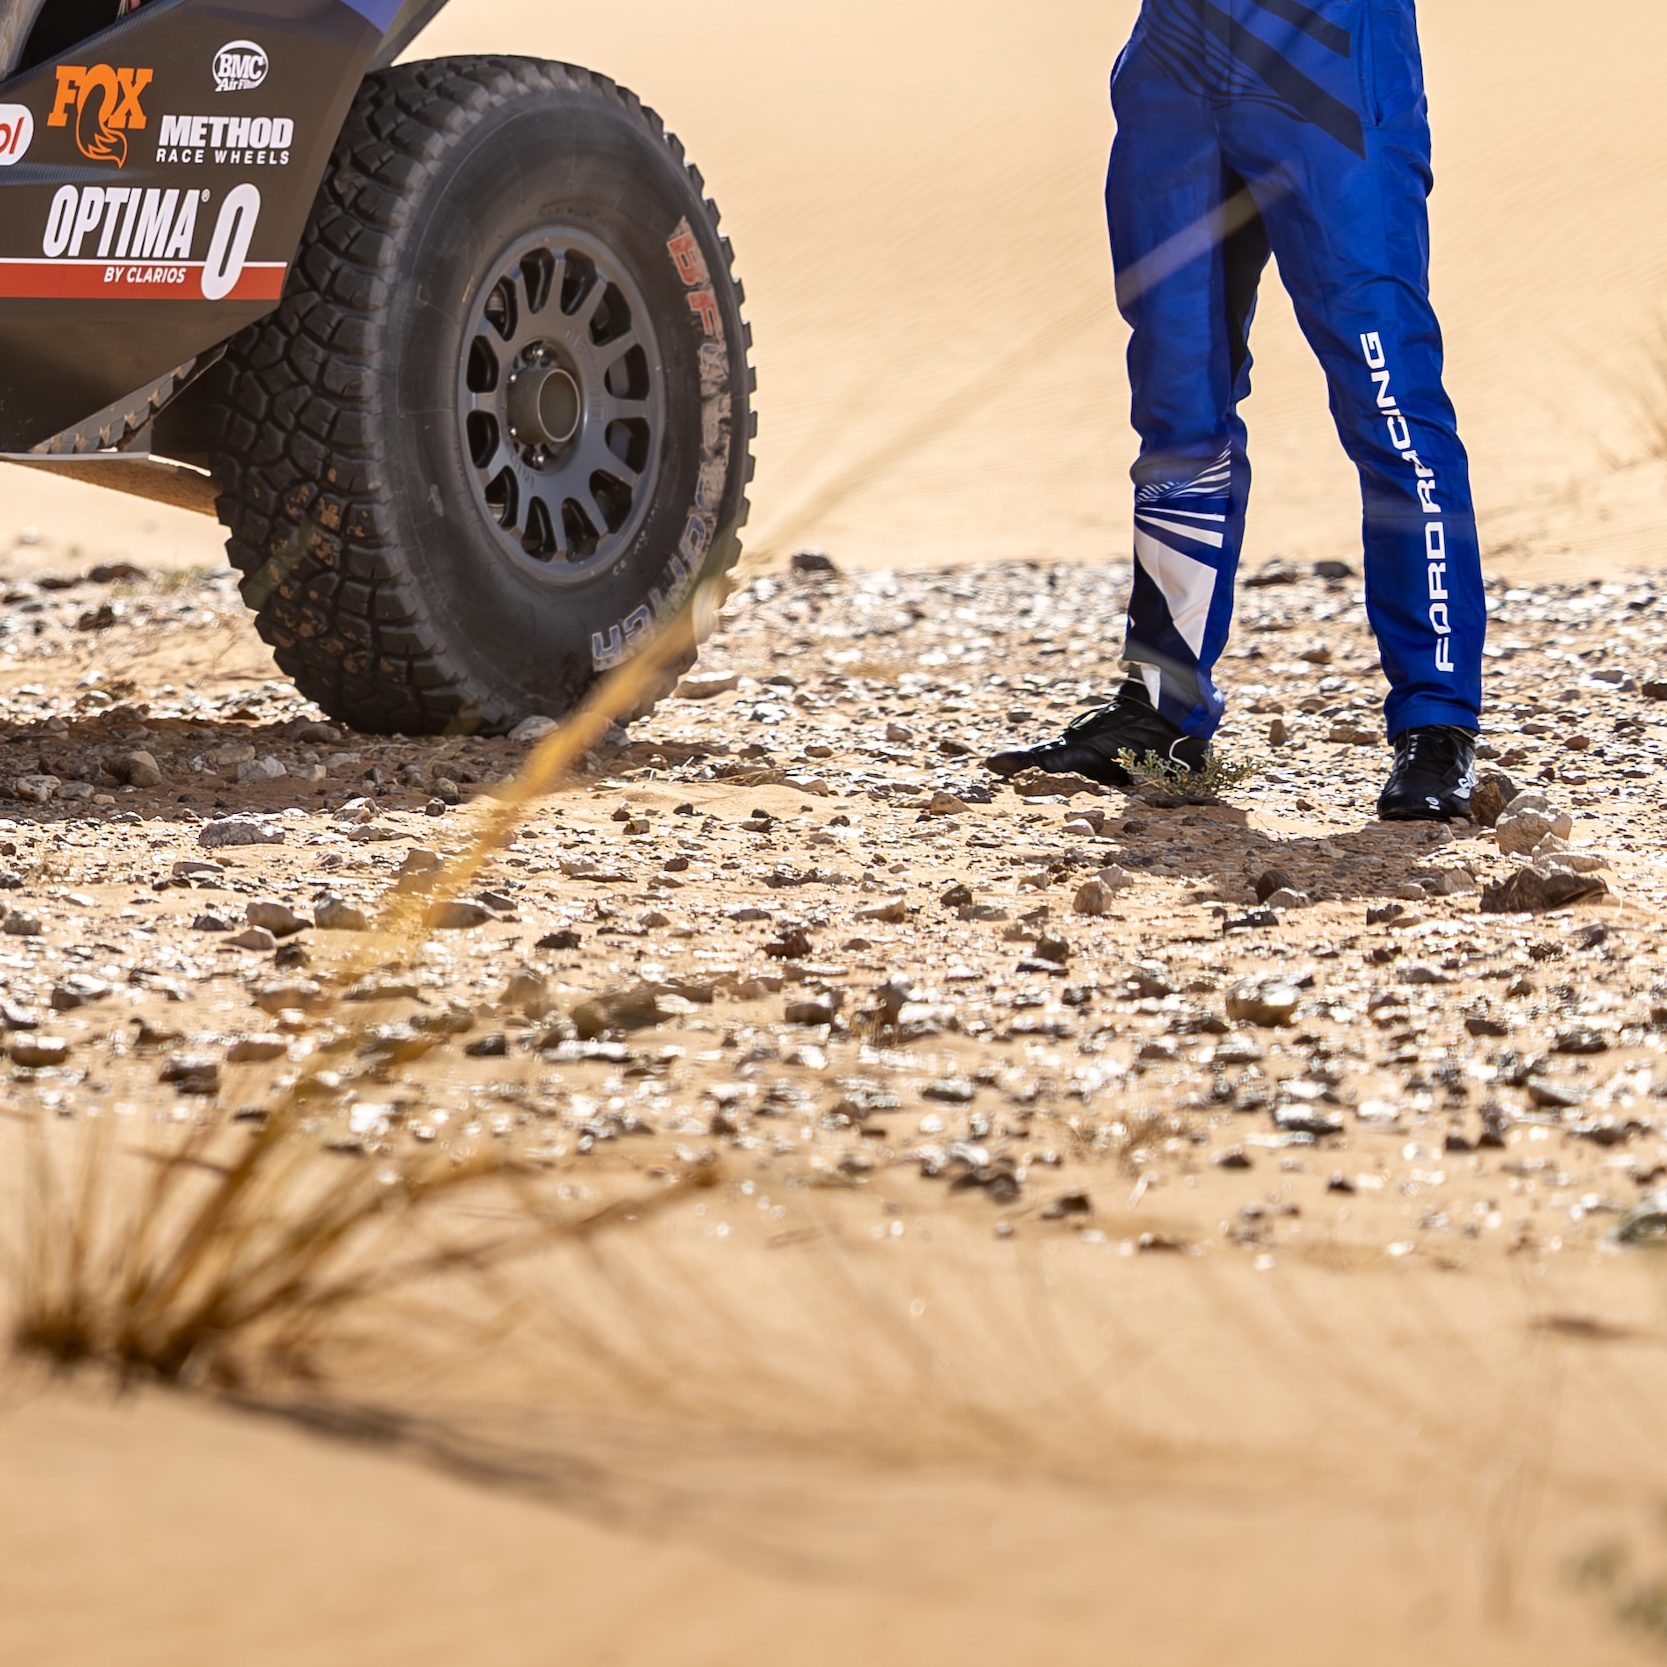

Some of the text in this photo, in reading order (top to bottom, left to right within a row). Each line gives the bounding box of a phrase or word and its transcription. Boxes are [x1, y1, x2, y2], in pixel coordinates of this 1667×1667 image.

[218, 54, 264, 80] BMC
[47, 64, 154, 134] FOX
[159, 115, 294, 149] METHOD
[156, 148, 290, 165] RACE WHEELS
[104, 267, 187, 284] BY CLARIOS
[1360, 331, 1455, 673] FORD RACING
